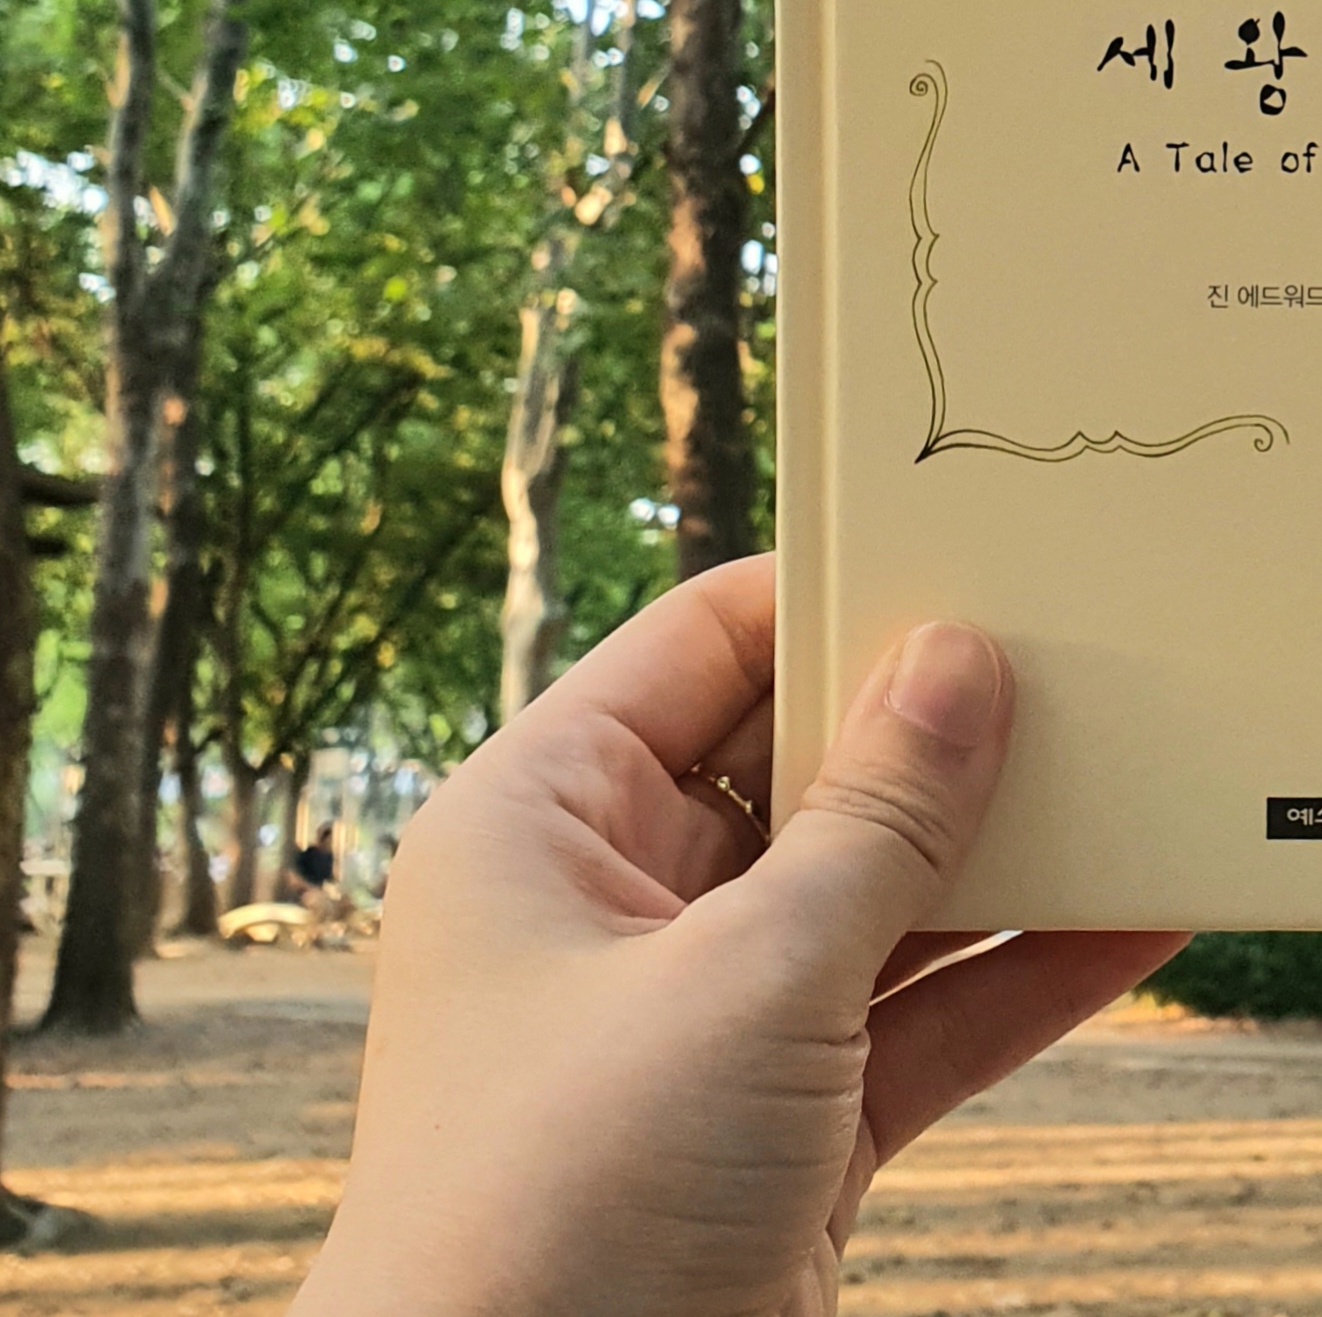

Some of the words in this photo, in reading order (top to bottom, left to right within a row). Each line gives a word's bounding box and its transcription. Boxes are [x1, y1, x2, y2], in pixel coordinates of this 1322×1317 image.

[1096, 18, 1176, 90] 세
[1223, 10, 1309, 117] 왕
[1116, 142, 1141, 174] A
[1165, 140, 1254, 174] Tale
[1280, 141, 1320, 174] of
[1207, 284, 1229, 309] 진
